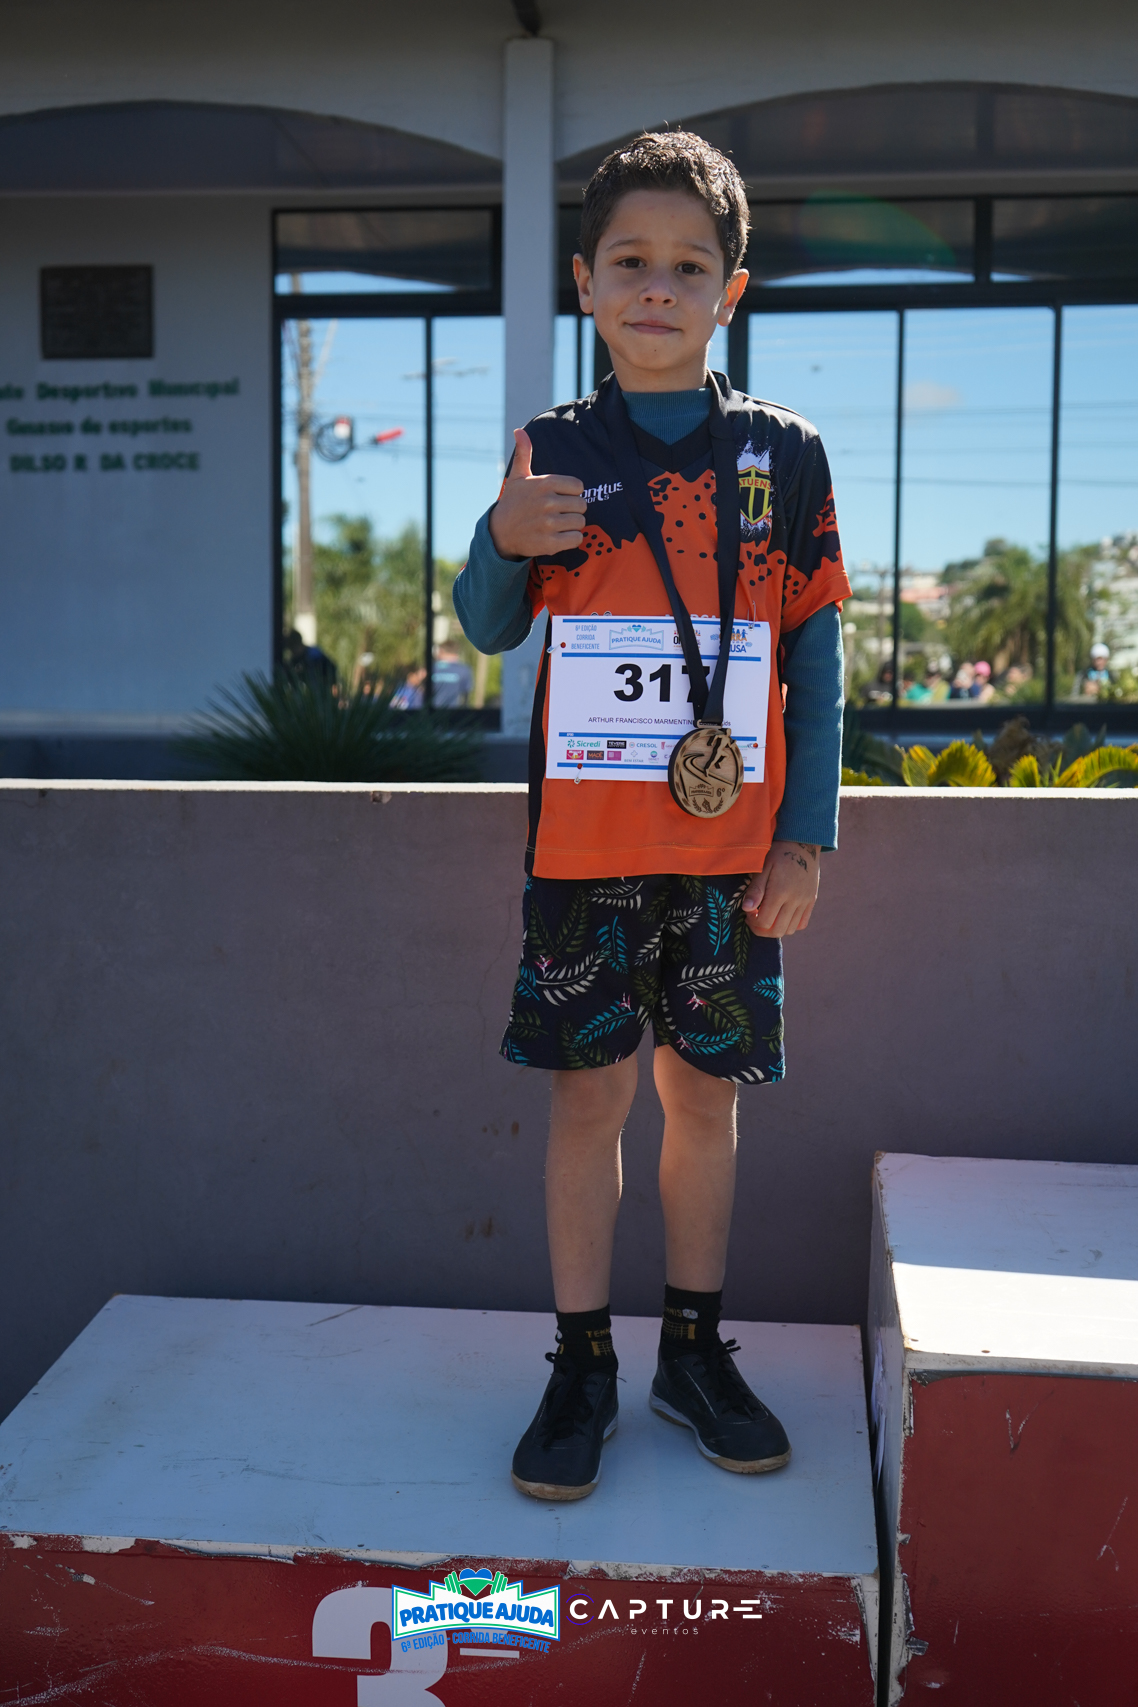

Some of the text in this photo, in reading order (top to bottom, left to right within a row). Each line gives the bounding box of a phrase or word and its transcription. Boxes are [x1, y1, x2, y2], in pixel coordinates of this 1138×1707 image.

[80, 415, 102, 435] de
[109, 416, 193, 437] esportes
[101, 453, 125, 471] DA
[581, 624, 597, 632] EDIÇÃO
